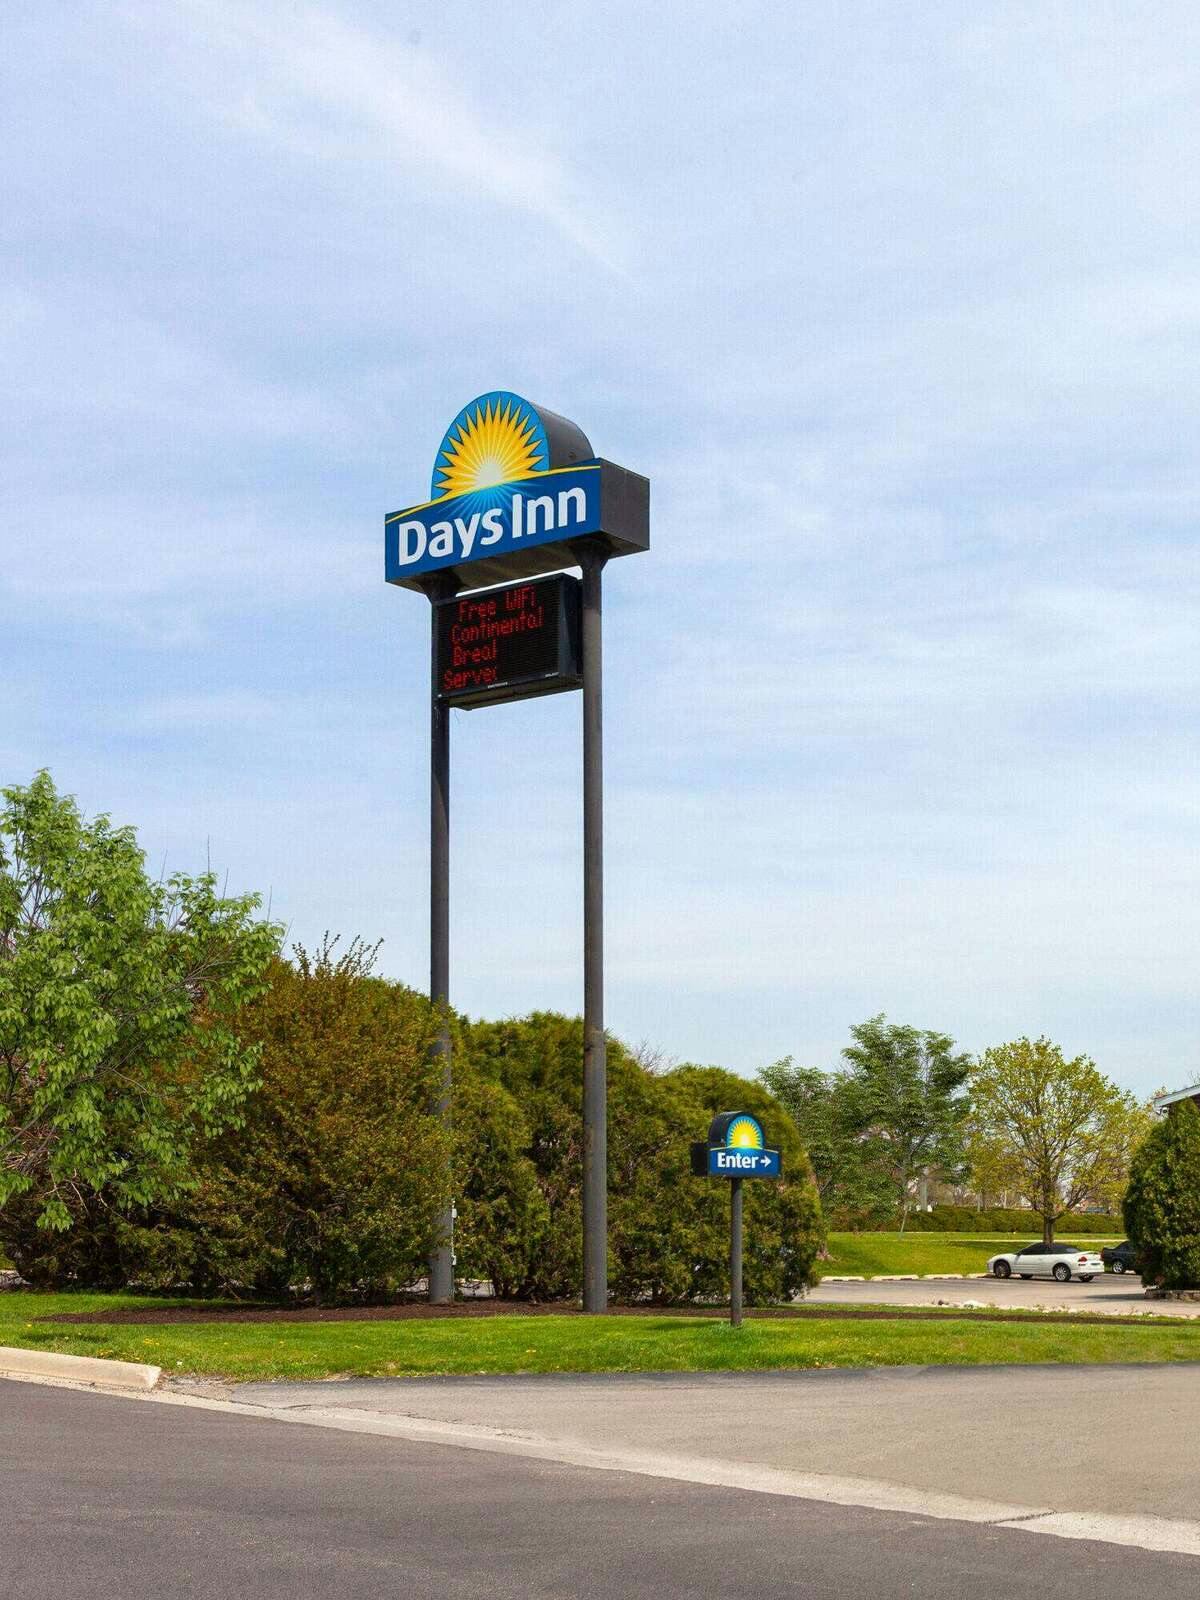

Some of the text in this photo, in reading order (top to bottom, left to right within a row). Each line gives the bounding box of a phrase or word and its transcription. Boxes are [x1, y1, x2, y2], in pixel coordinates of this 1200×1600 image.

[398, 486, 587, 566] Days Inn
[450, 605, 545, 643] Continental
[458, 600, 497, 623] Free
[717, 1152, 759, 1169] Enter
